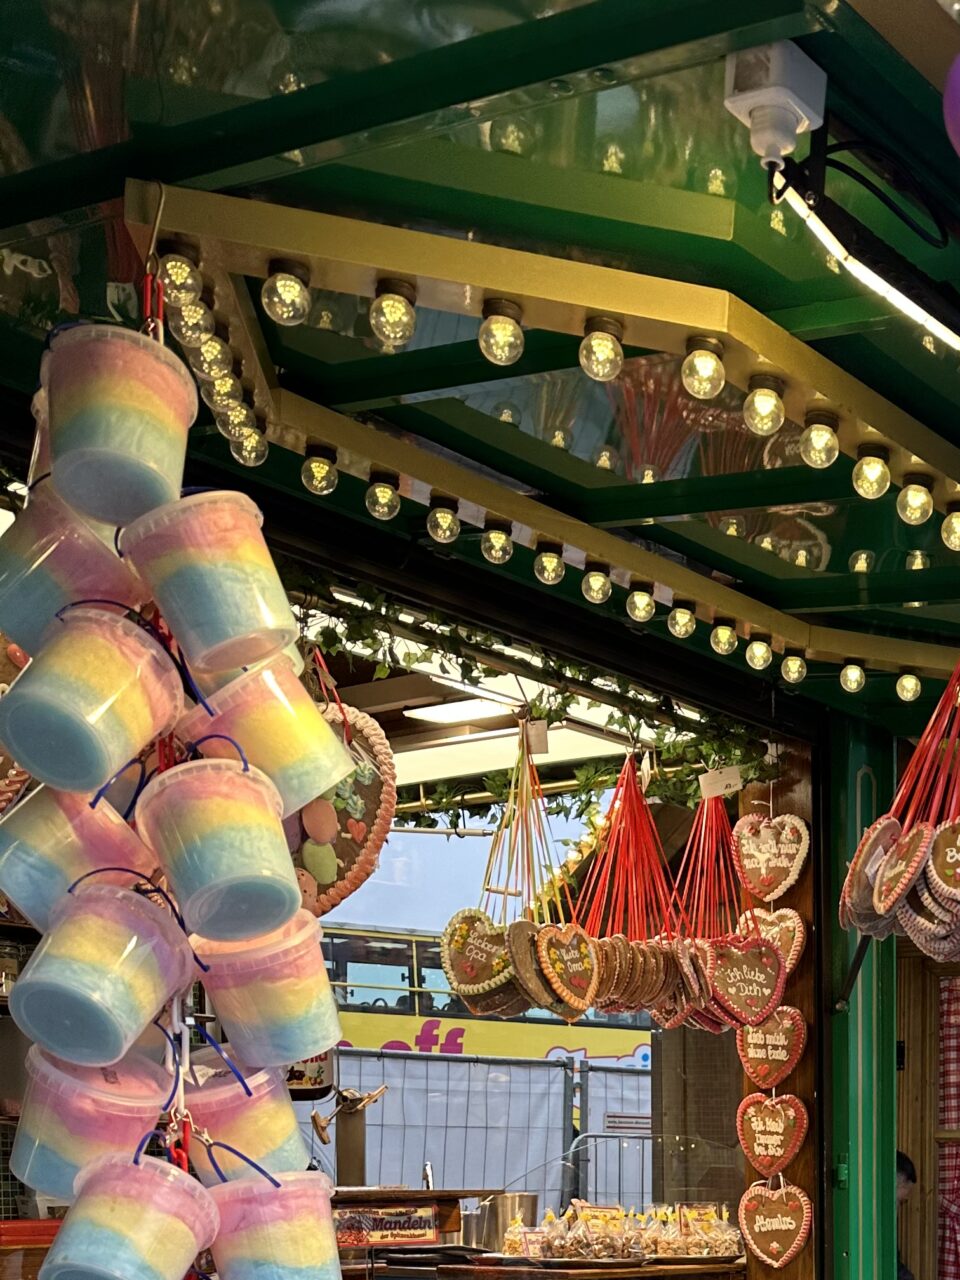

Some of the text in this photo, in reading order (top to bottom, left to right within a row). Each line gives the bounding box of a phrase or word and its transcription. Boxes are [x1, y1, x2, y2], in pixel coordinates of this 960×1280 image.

[465, 945, 487, 961] Opa
[567, 961, 584, 973] Oma
[724, 965, 767, 984] Ich liebe
[736, 982, 762, 997] Dich
[372, 1216, 433, 1231] Mandeln
